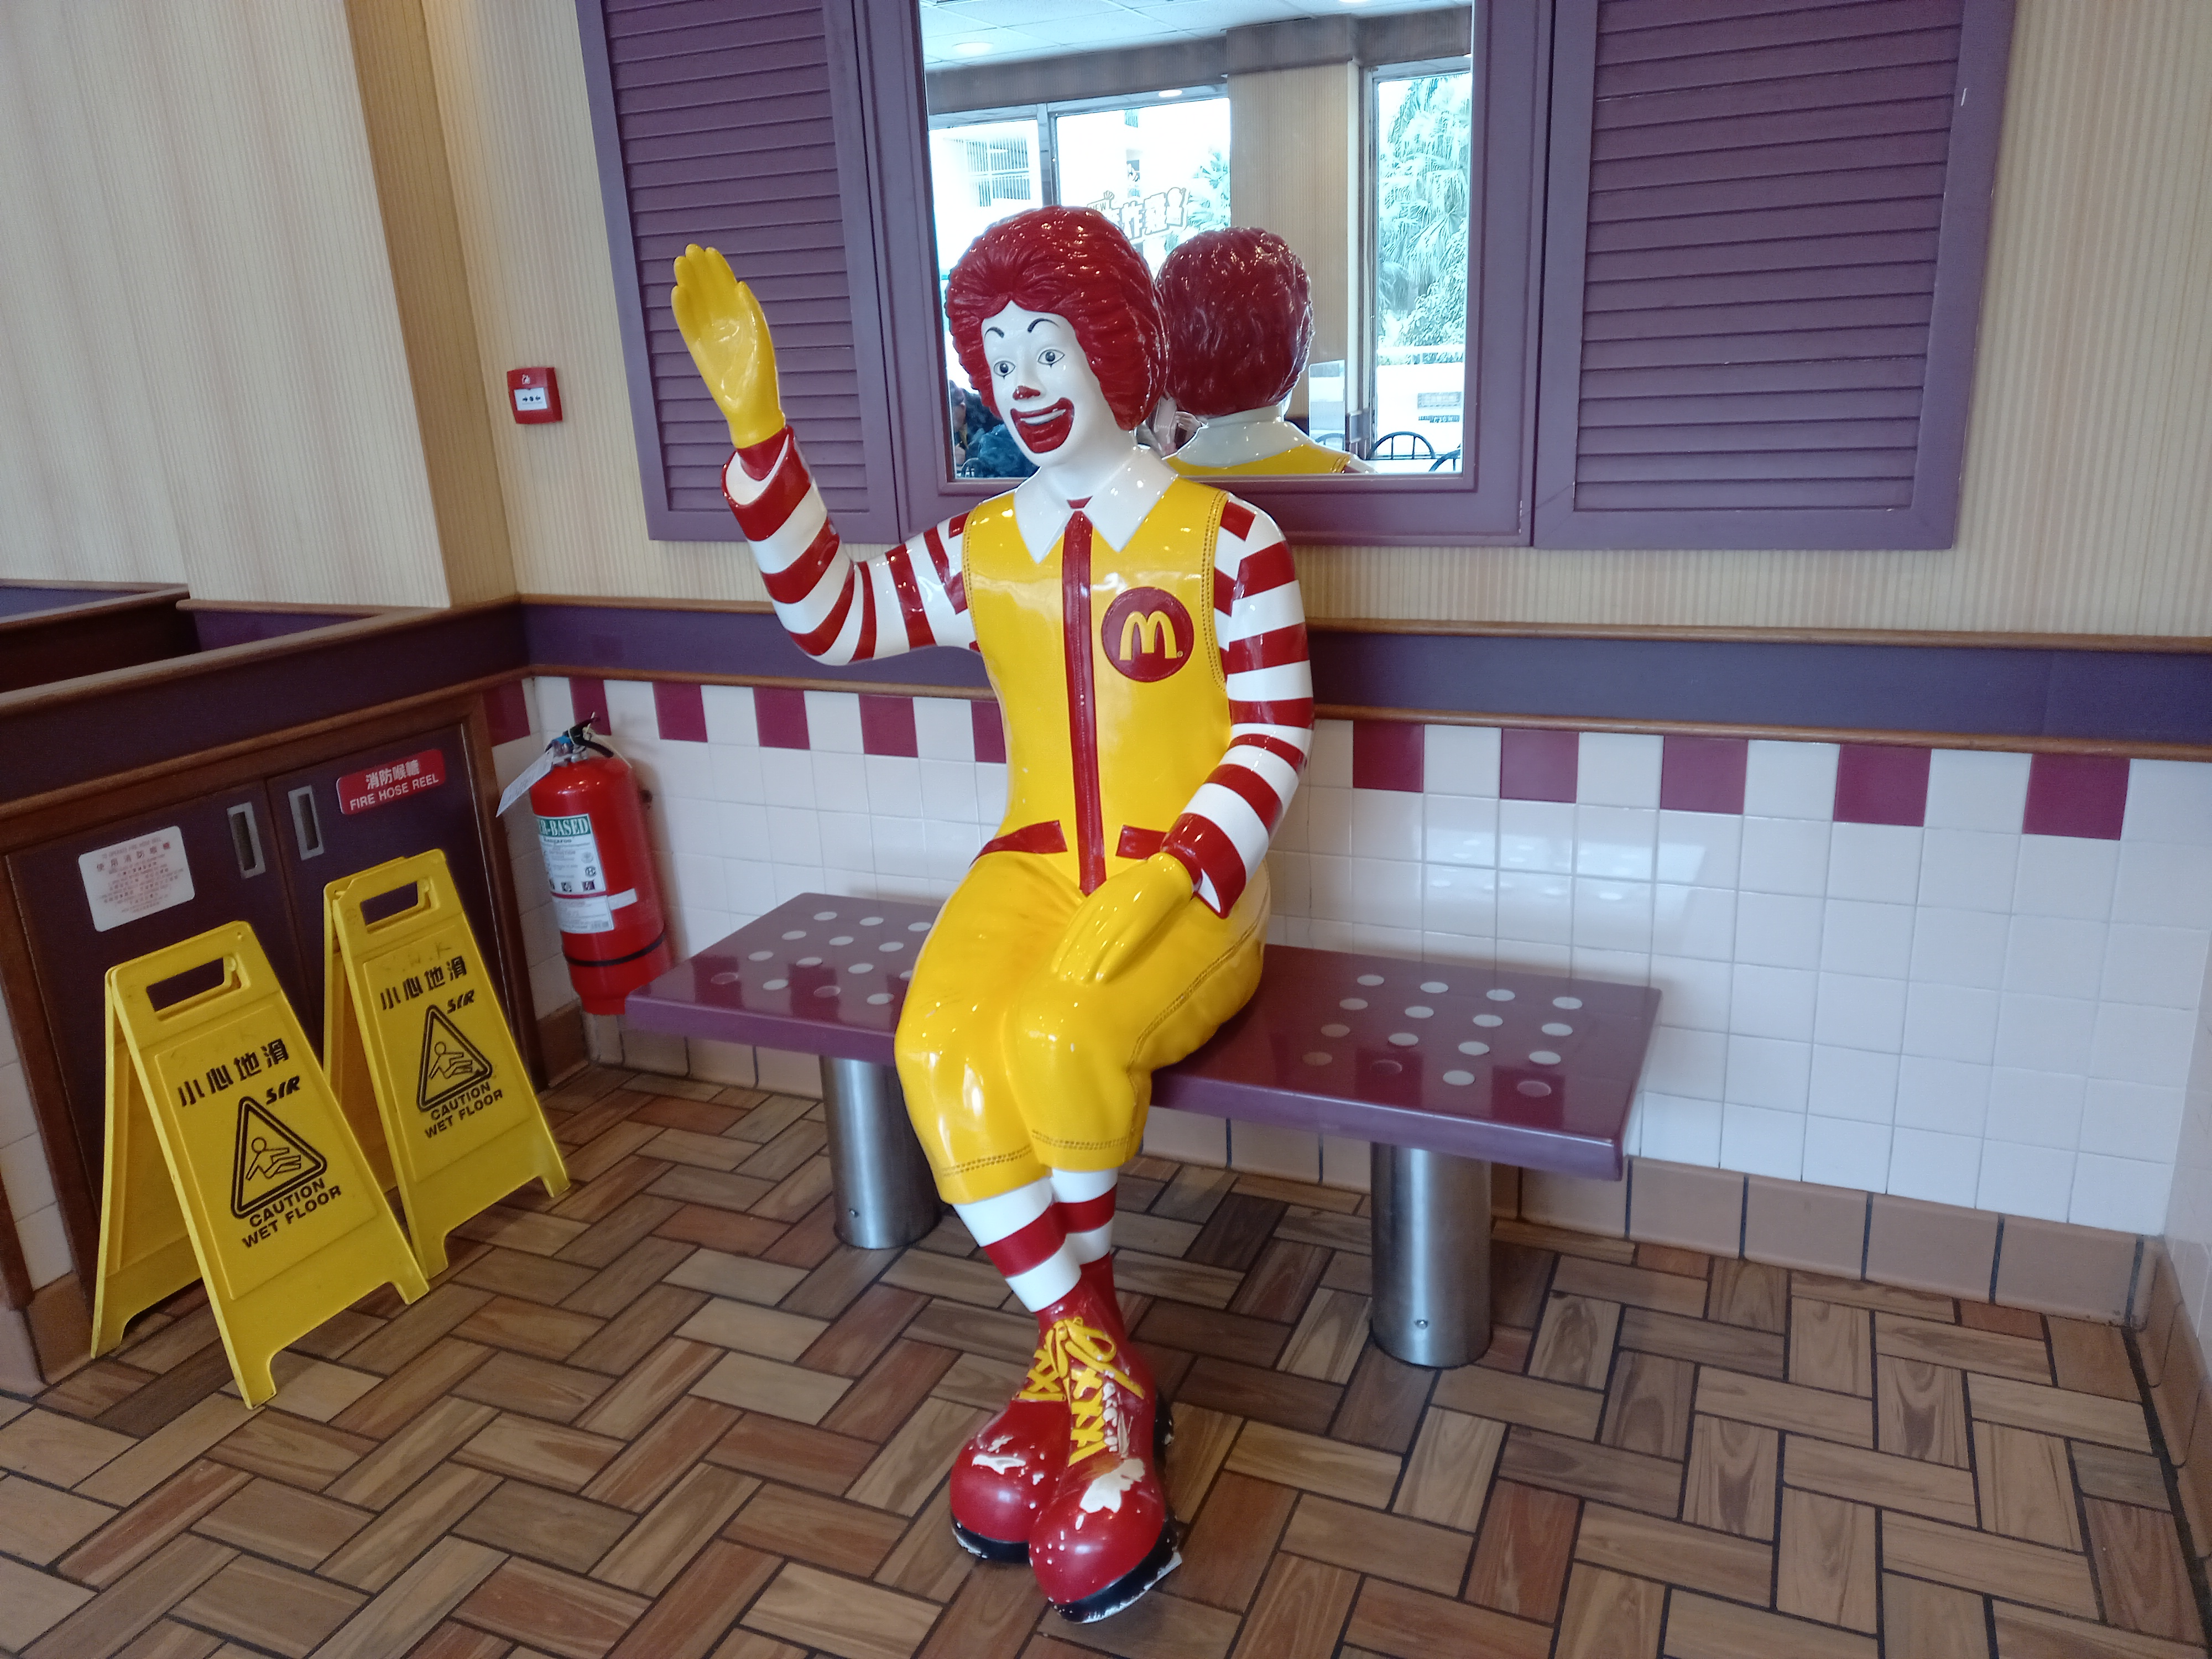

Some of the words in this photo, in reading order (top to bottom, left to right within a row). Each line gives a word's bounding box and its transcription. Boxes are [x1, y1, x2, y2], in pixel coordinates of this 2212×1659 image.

[349, 793, 375, 811] FIRE
[378, 782, 409, 801] HOSE
[412, 773, 439, 790] REEL
[380, 955, 467, 1010] 小心地滑
[446, 989, 474, 1014] SIR
[178, 1038, 289, 1107] 小心地滑
[266, 1075, 300, 1105] SIR
[424, 1115, 453, 1139] WET
[458, 1089, 503, 1121] FLOOR
[430, 1081, 491, 1121] CAUTION
[242, 1220, 279, 1248] WET
[285, 1185, 341, 1225] FLOOR
[249, 1178, 325, 1228] CAUTION
